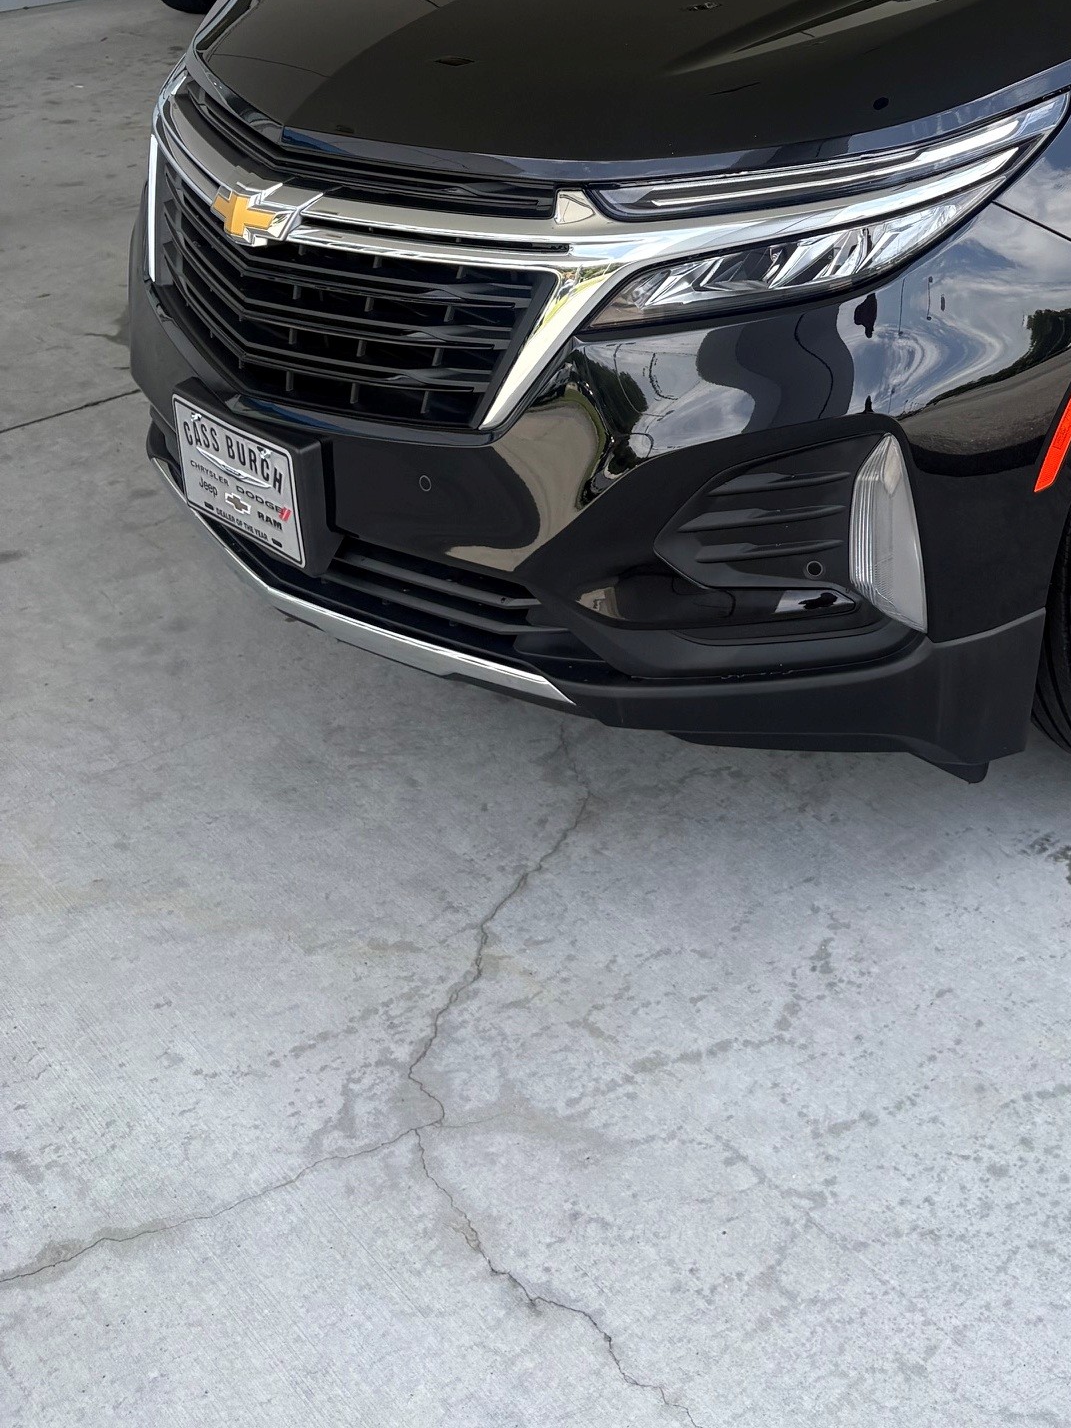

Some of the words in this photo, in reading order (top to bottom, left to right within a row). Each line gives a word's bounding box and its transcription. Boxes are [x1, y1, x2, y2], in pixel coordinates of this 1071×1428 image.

[183, 420, 220, 452] CASS
[225, 434, 283, 494] BURCH
[190, 460, 230, 487] CHRYSLER
[199, 477, 218, 498] Jeep
[236, 485, 283, 514] DODGE
[216, 507, 236, 524] DEALER
[236, 516, 243, 528] OF
[243, 520, 255, 535] THE
[255, 526, 269, 542] YEAR
[257, 510, 283, 531] RAM
